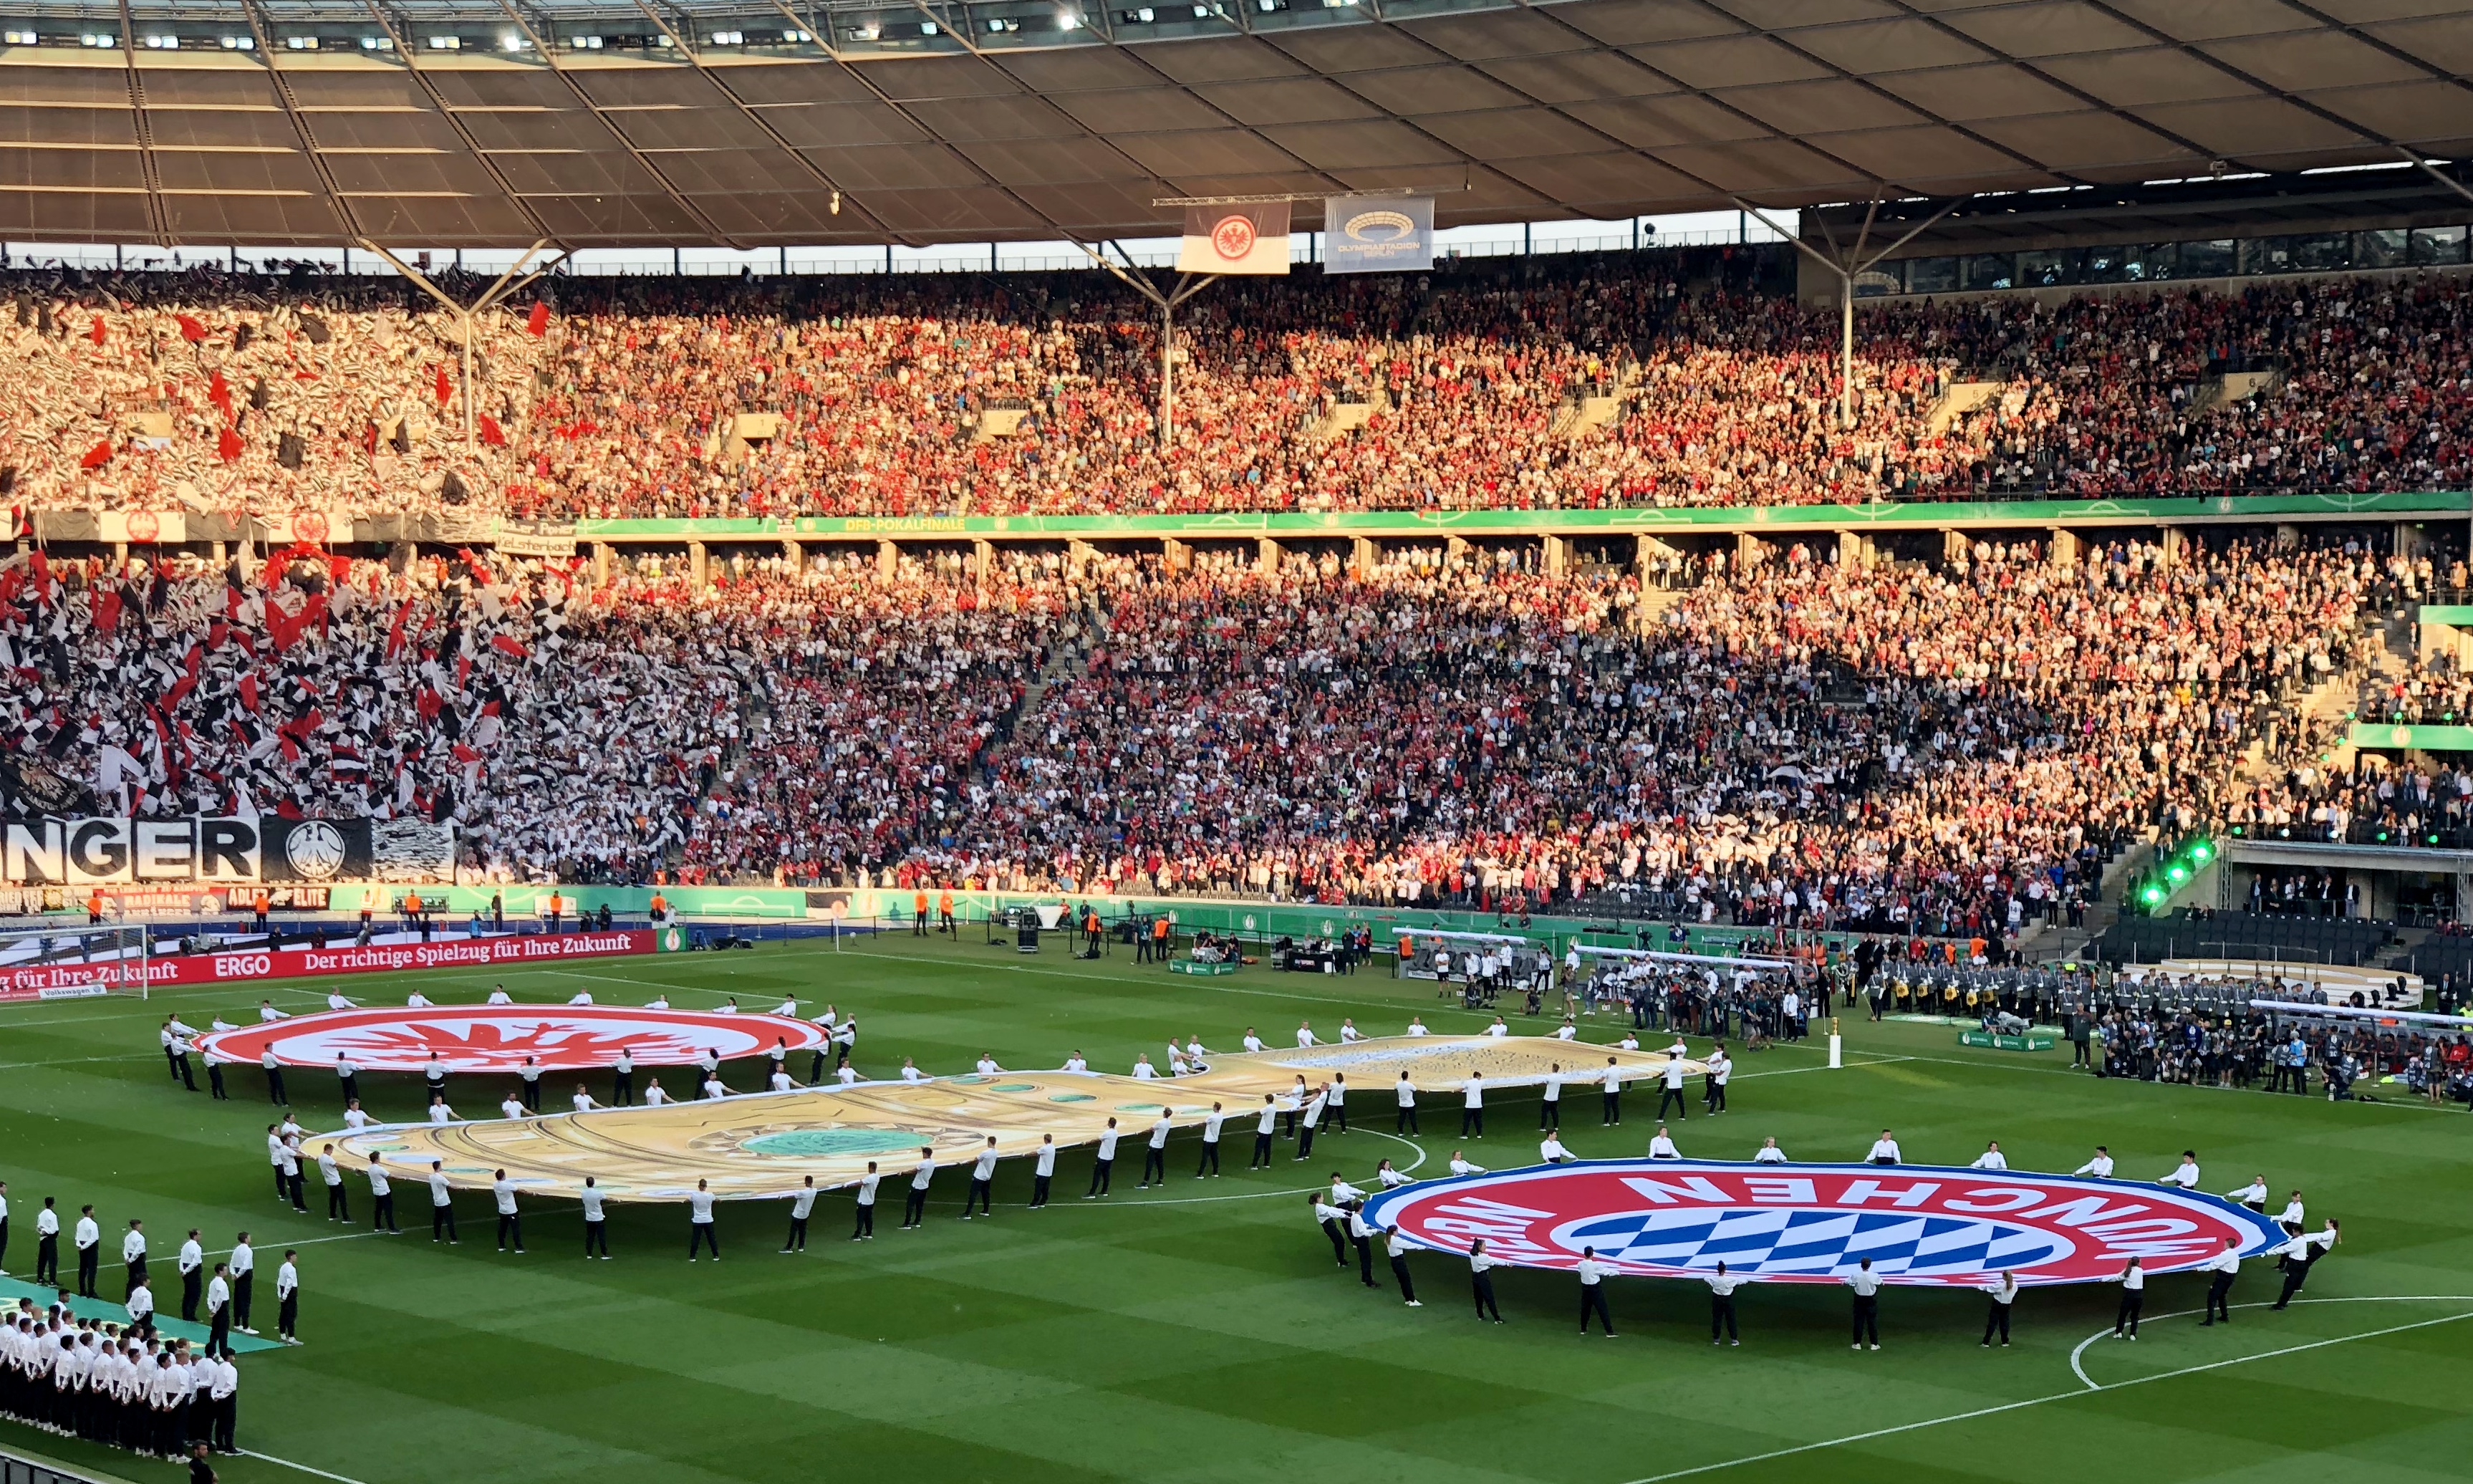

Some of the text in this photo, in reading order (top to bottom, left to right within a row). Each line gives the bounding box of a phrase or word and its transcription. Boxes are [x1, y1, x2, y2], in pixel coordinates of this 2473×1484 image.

[1358, 409, 1364, 418] 3
[1607, 403, 1614, 412] 4
[1007, 415, 1014, 424] 2
[845, 518, 965, 531] DFB-POKALFINALE
[1639, 542, 1647, 552] B
[125, 895, 191, 907] RADIKALE
[293, 887, 327, 907] ELITE
[304, 933, 632, 970] Der richtige Spielzug für Ihre Zukunft
[215, 955, 271, 977] ERGO
[14, 970, 47, 990] für
[50, 968, 93, 987] Ihre
[96, 960, 178, 983] Zukunft
[44, 988, 90, 997] Volkswagen
